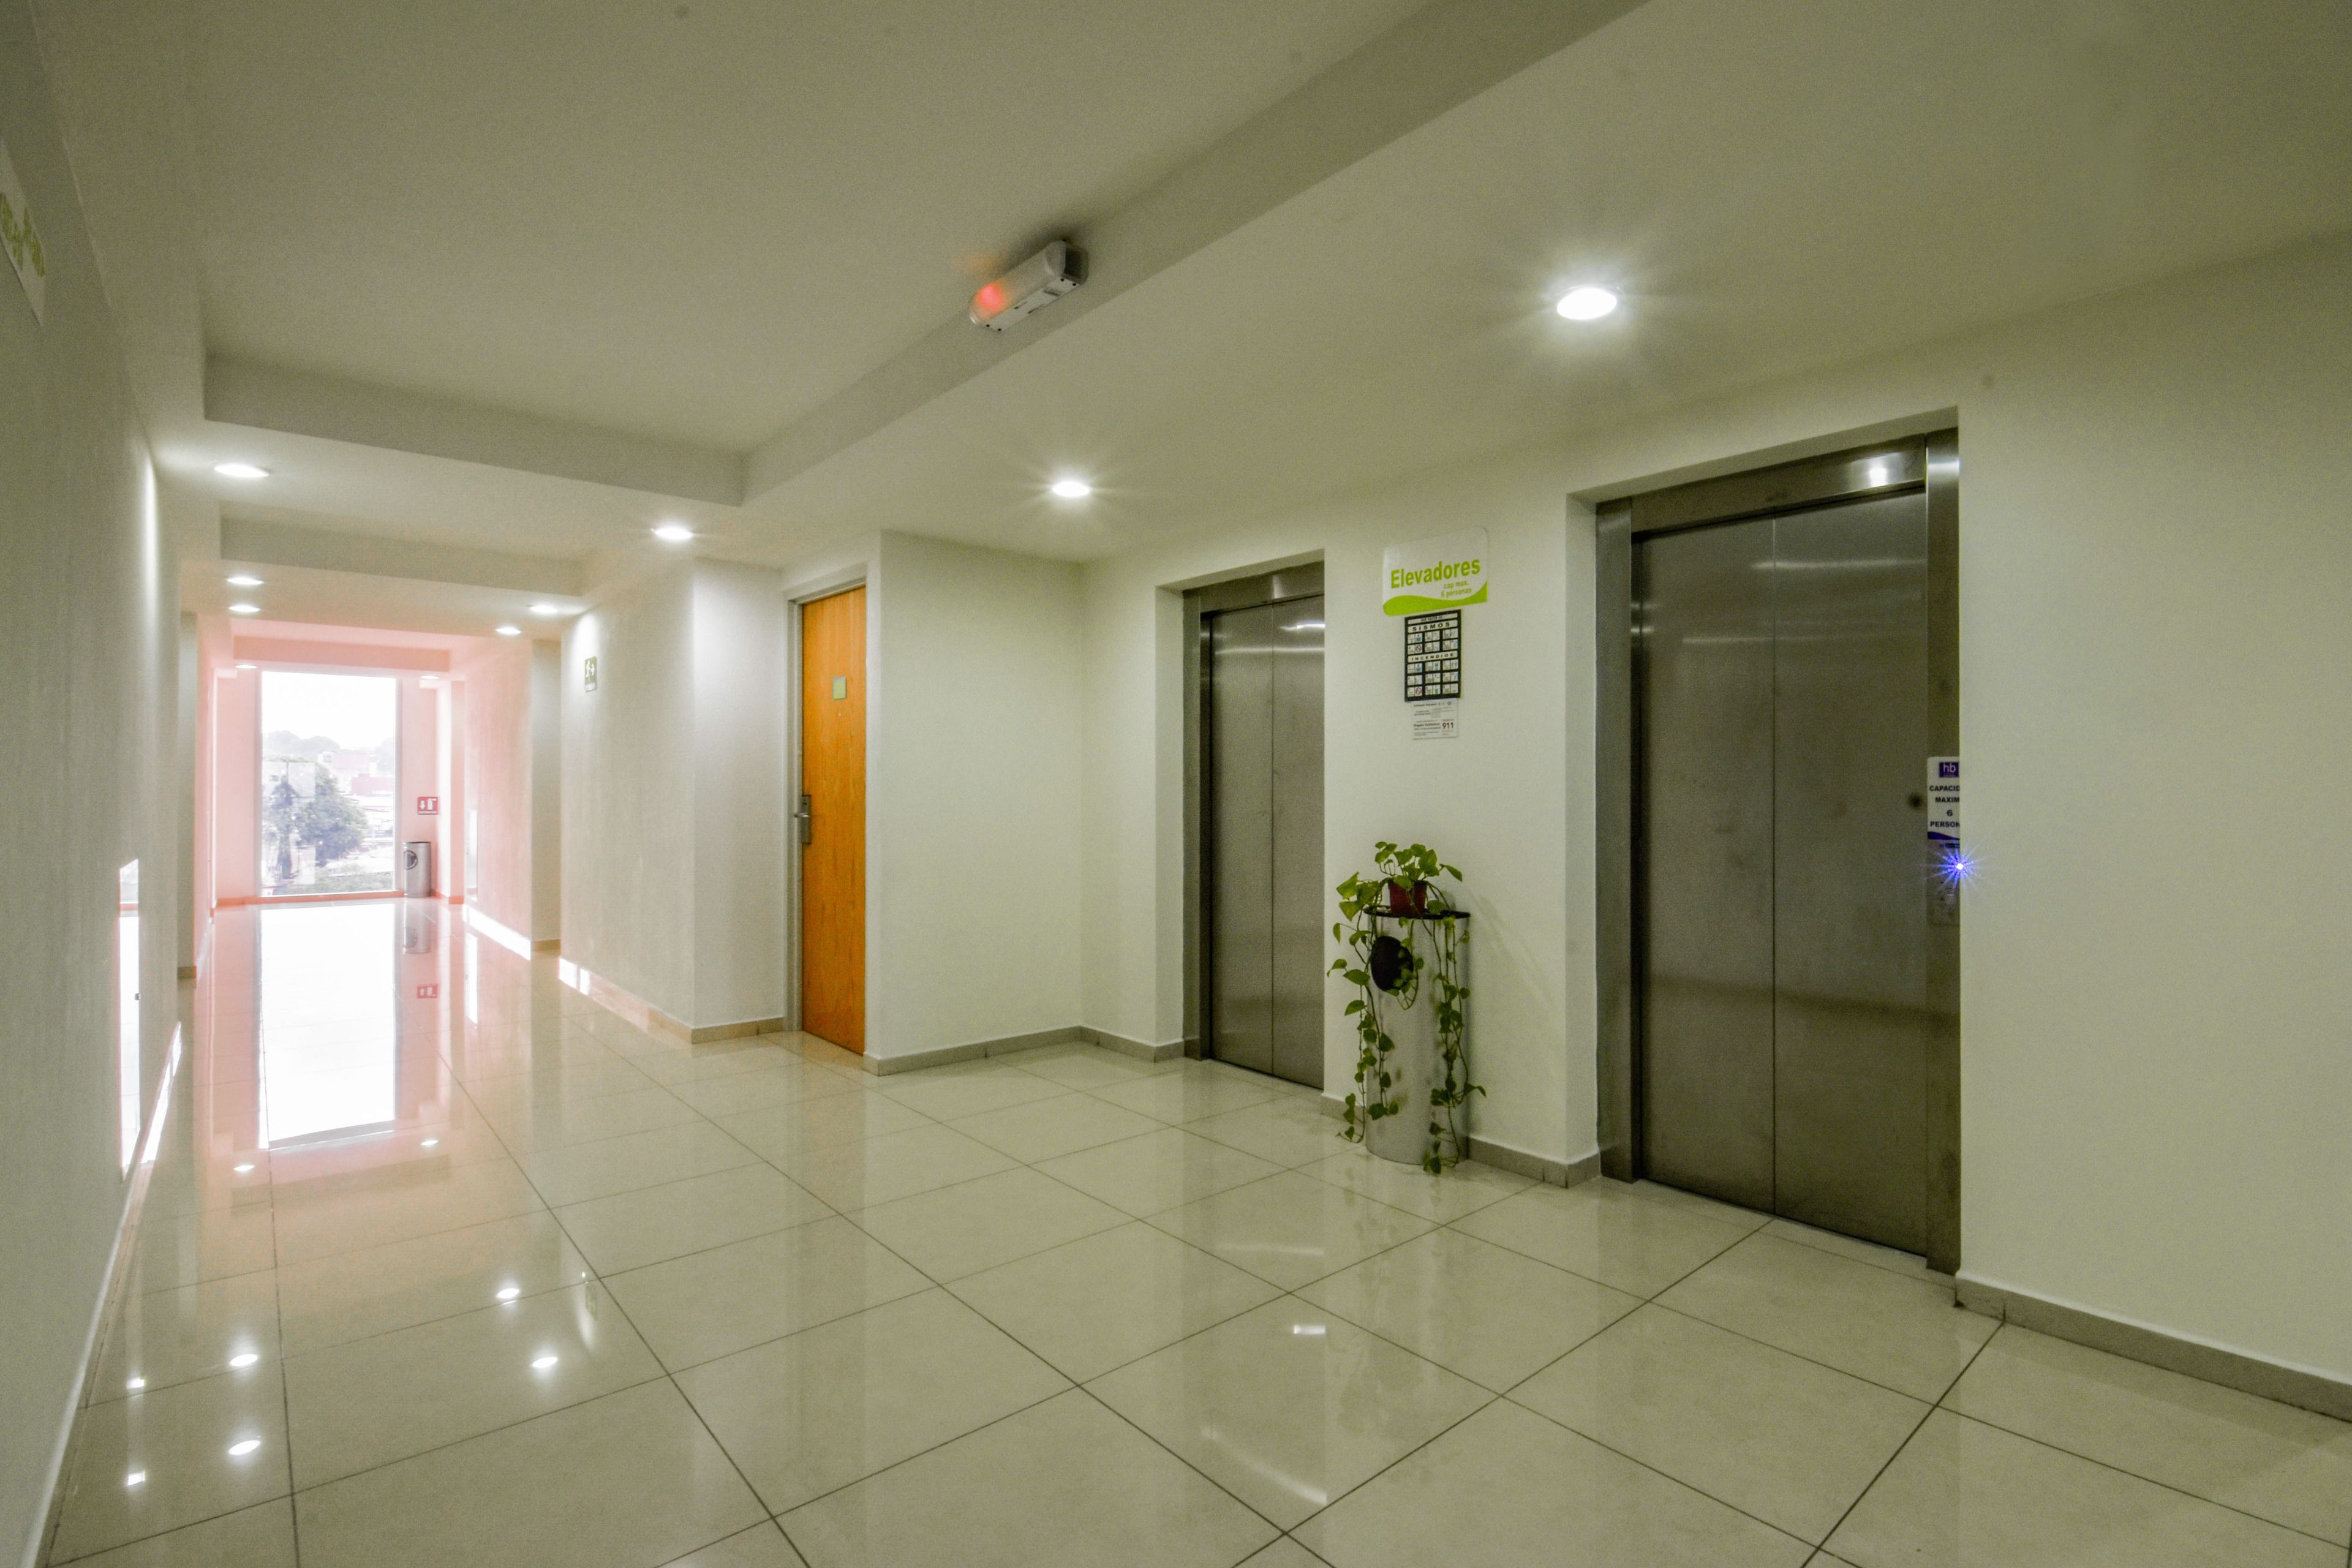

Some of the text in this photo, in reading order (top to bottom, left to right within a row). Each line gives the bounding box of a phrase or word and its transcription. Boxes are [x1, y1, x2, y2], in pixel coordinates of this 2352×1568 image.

[1391, 559, 1480, 589] Elevadores
[1446, 587, 1472, 598] personas
[1412, 622, 1450, 631] SISMOS
[1943, 763, 1956, 773] hb
